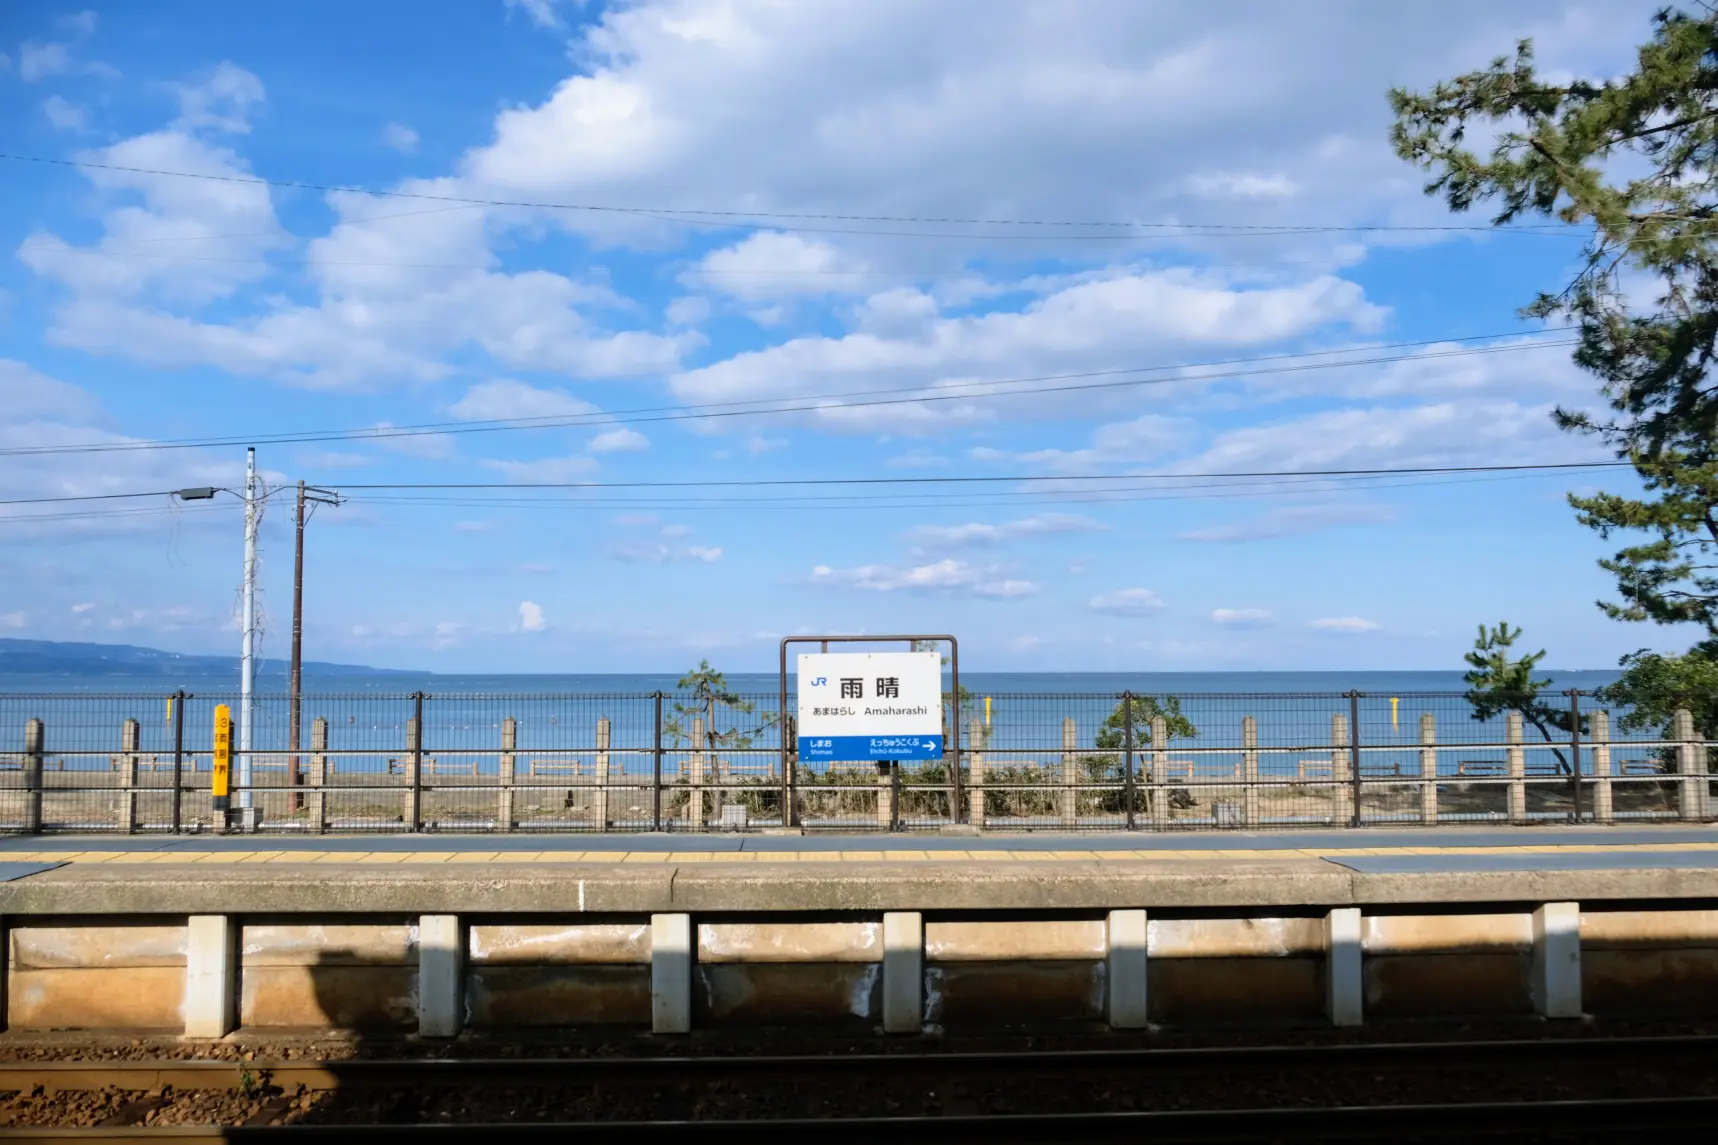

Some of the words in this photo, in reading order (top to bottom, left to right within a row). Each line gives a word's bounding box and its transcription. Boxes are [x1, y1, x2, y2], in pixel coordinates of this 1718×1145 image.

[811, 677, 827, 687] JR
[840, 677, 900, 699] 雨晴
[813, 707, 856, 716] あまはらし
[864, 706, 927, 716] Amaharashi
[810, 739, 833, 748] しまお
[870, 738, 920, 748] えっちゅうこくぶ
